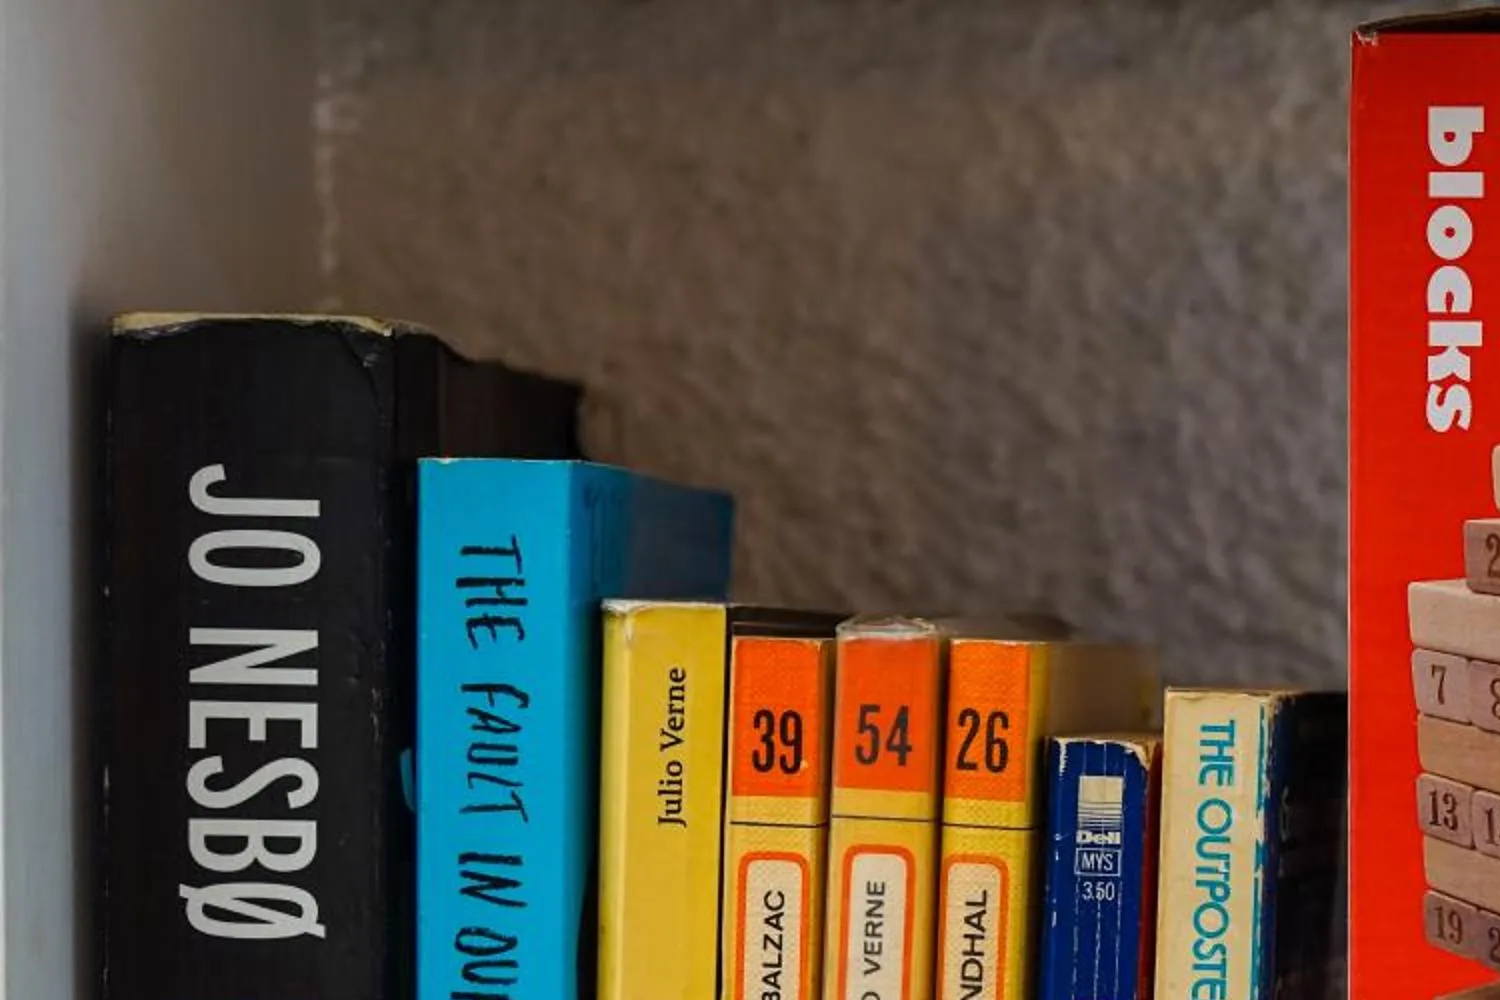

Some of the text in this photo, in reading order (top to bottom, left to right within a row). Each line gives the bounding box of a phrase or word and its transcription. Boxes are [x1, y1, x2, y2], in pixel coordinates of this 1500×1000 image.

[1425, 106, 1484, 432] blocks
[455, 534, 529, 650] THE
[179, 463, 326, 940] JO NESBØ
[1431, 664, 1447, 704] 7
[459, 682, 530, 823] FAULT
[657, 667, 688, 828] Julio Verne
[751, 709, 804, 774] 39
[854, 704, 913, 766] 54
[956, 709, 1009, 773] 26
[1199, 719, 1236, 785] THE
[1076, 831, 1121, 844] Dell
[1429, 790, 1459, 832] 13
[457, 851, 528, 908] IN
[1081, 852, 1114, 871] MYS
[1082, 881, 1116, 901] 3.50
[862, 880, 886, 976] VERNE
[1434, 905, 1463, 945] 19
